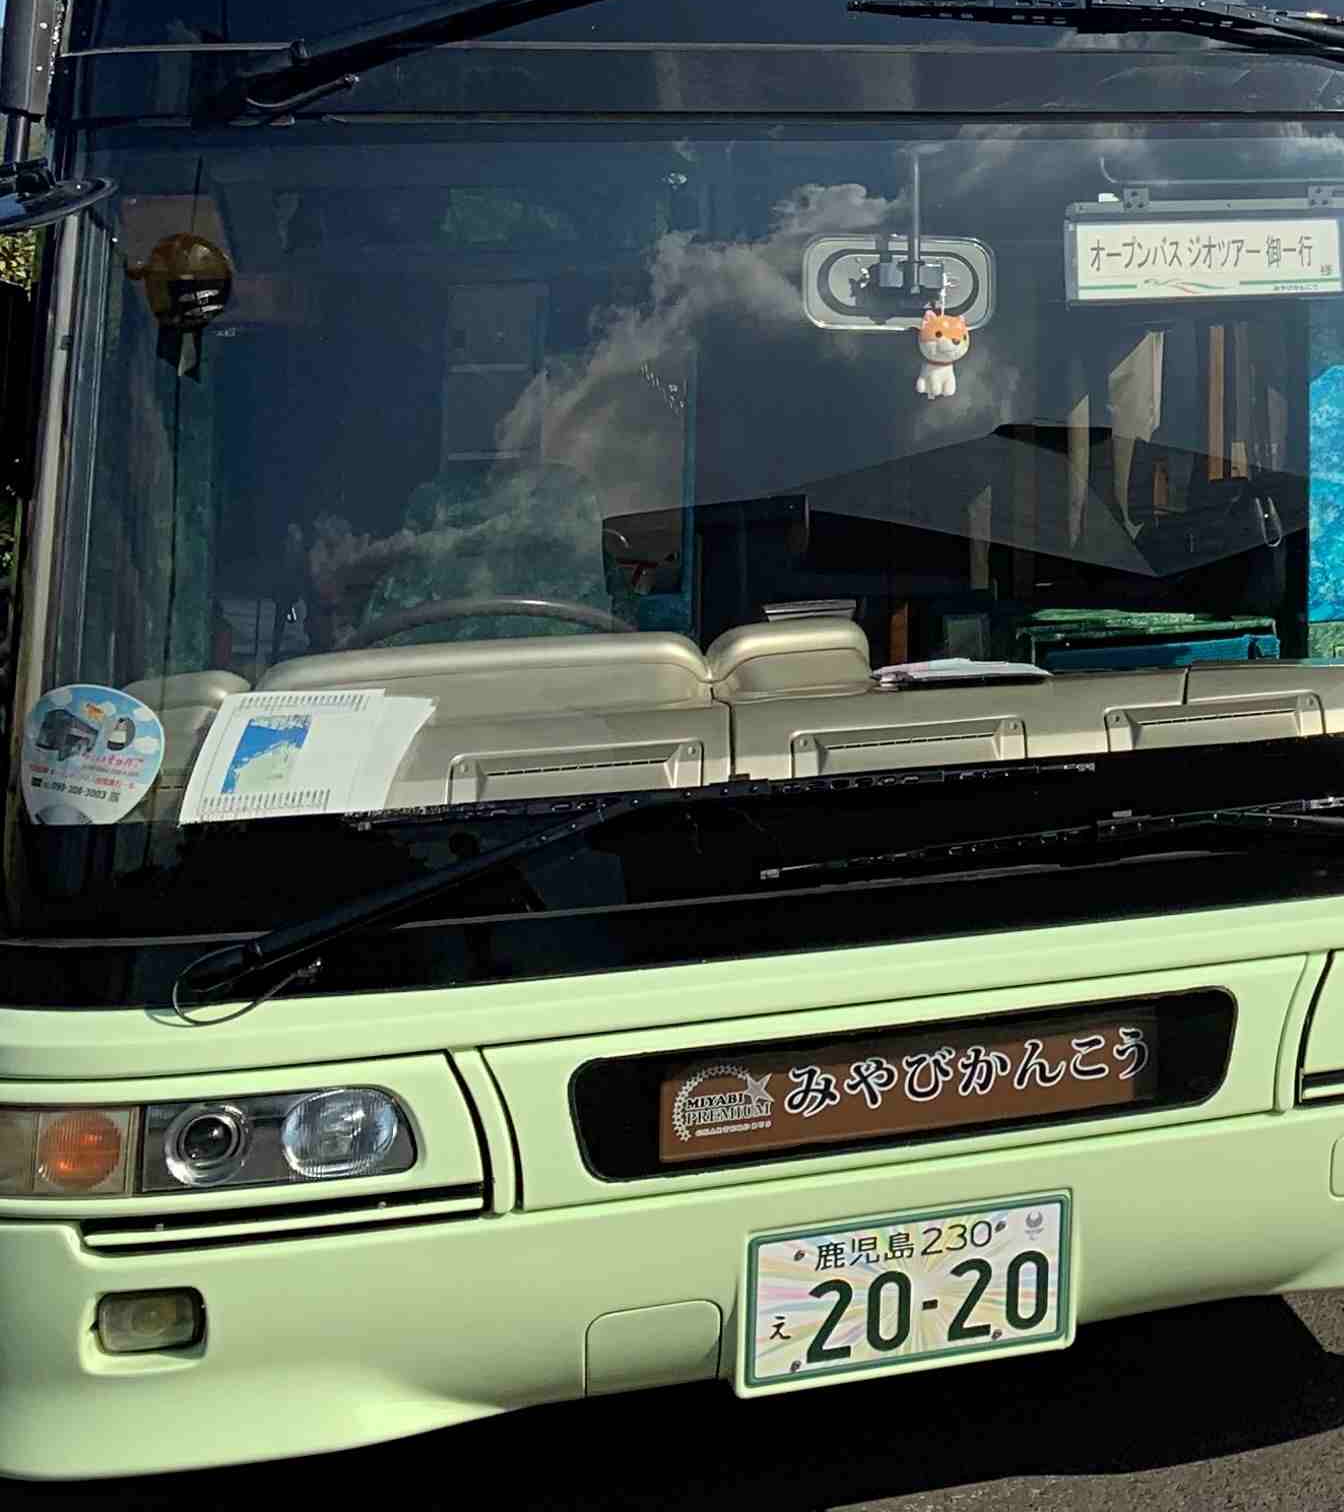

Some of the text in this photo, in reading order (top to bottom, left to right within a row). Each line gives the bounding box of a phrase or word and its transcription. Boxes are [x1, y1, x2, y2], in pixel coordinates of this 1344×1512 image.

[1187, 235, 1261, 268] ジオツアー
[1265, 235, 1313, 268] 御一行
[783, 1026, 1150, 1118] みやびかんこう
[686, 1103, 772, 1126] PREMIUM
[688, 1093, 744, 1109] MIYABI
[814, 1219, 992, 1271] 鹿児島230
[805, 1250, 1050, 1364] 20-20
[769, 1315, 790, 1340] え
